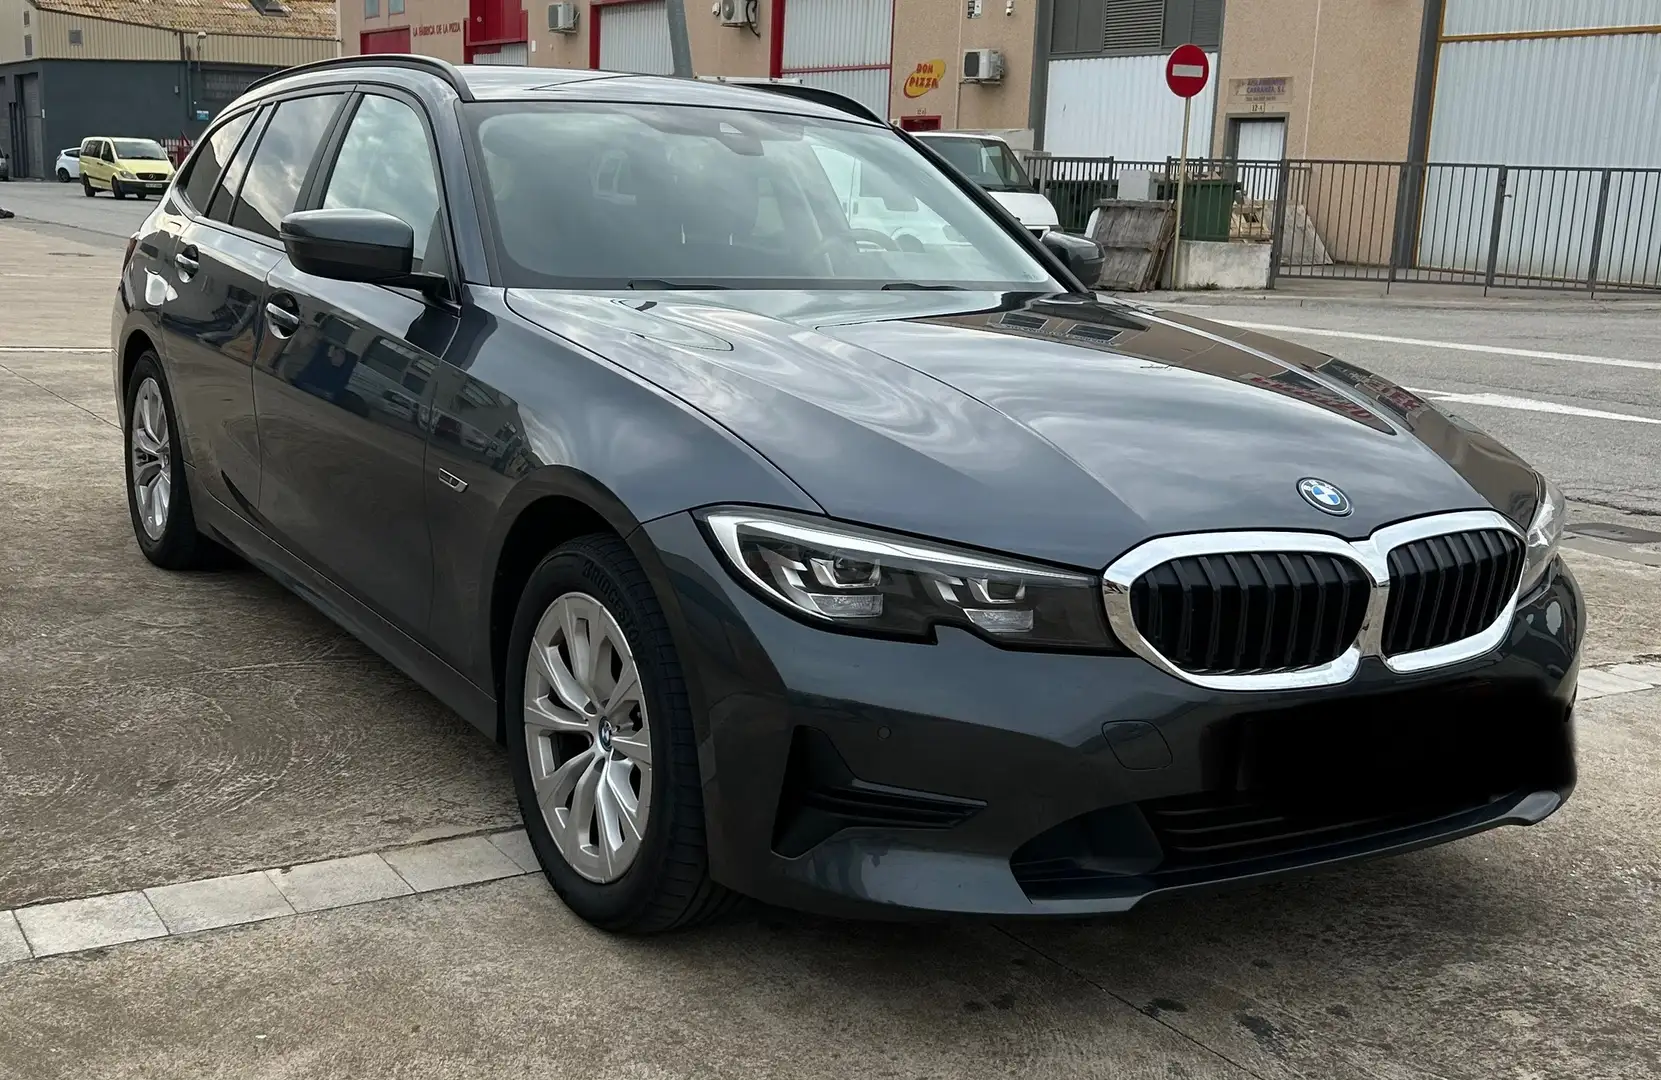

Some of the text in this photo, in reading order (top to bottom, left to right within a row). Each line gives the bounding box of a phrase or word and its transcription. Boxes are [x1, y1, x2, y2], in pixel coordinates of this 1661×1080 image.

[436, 25, 442, 35] DE
[443, 24, 449, 34] LA
[909, 77, 939, 88] PIZZA
